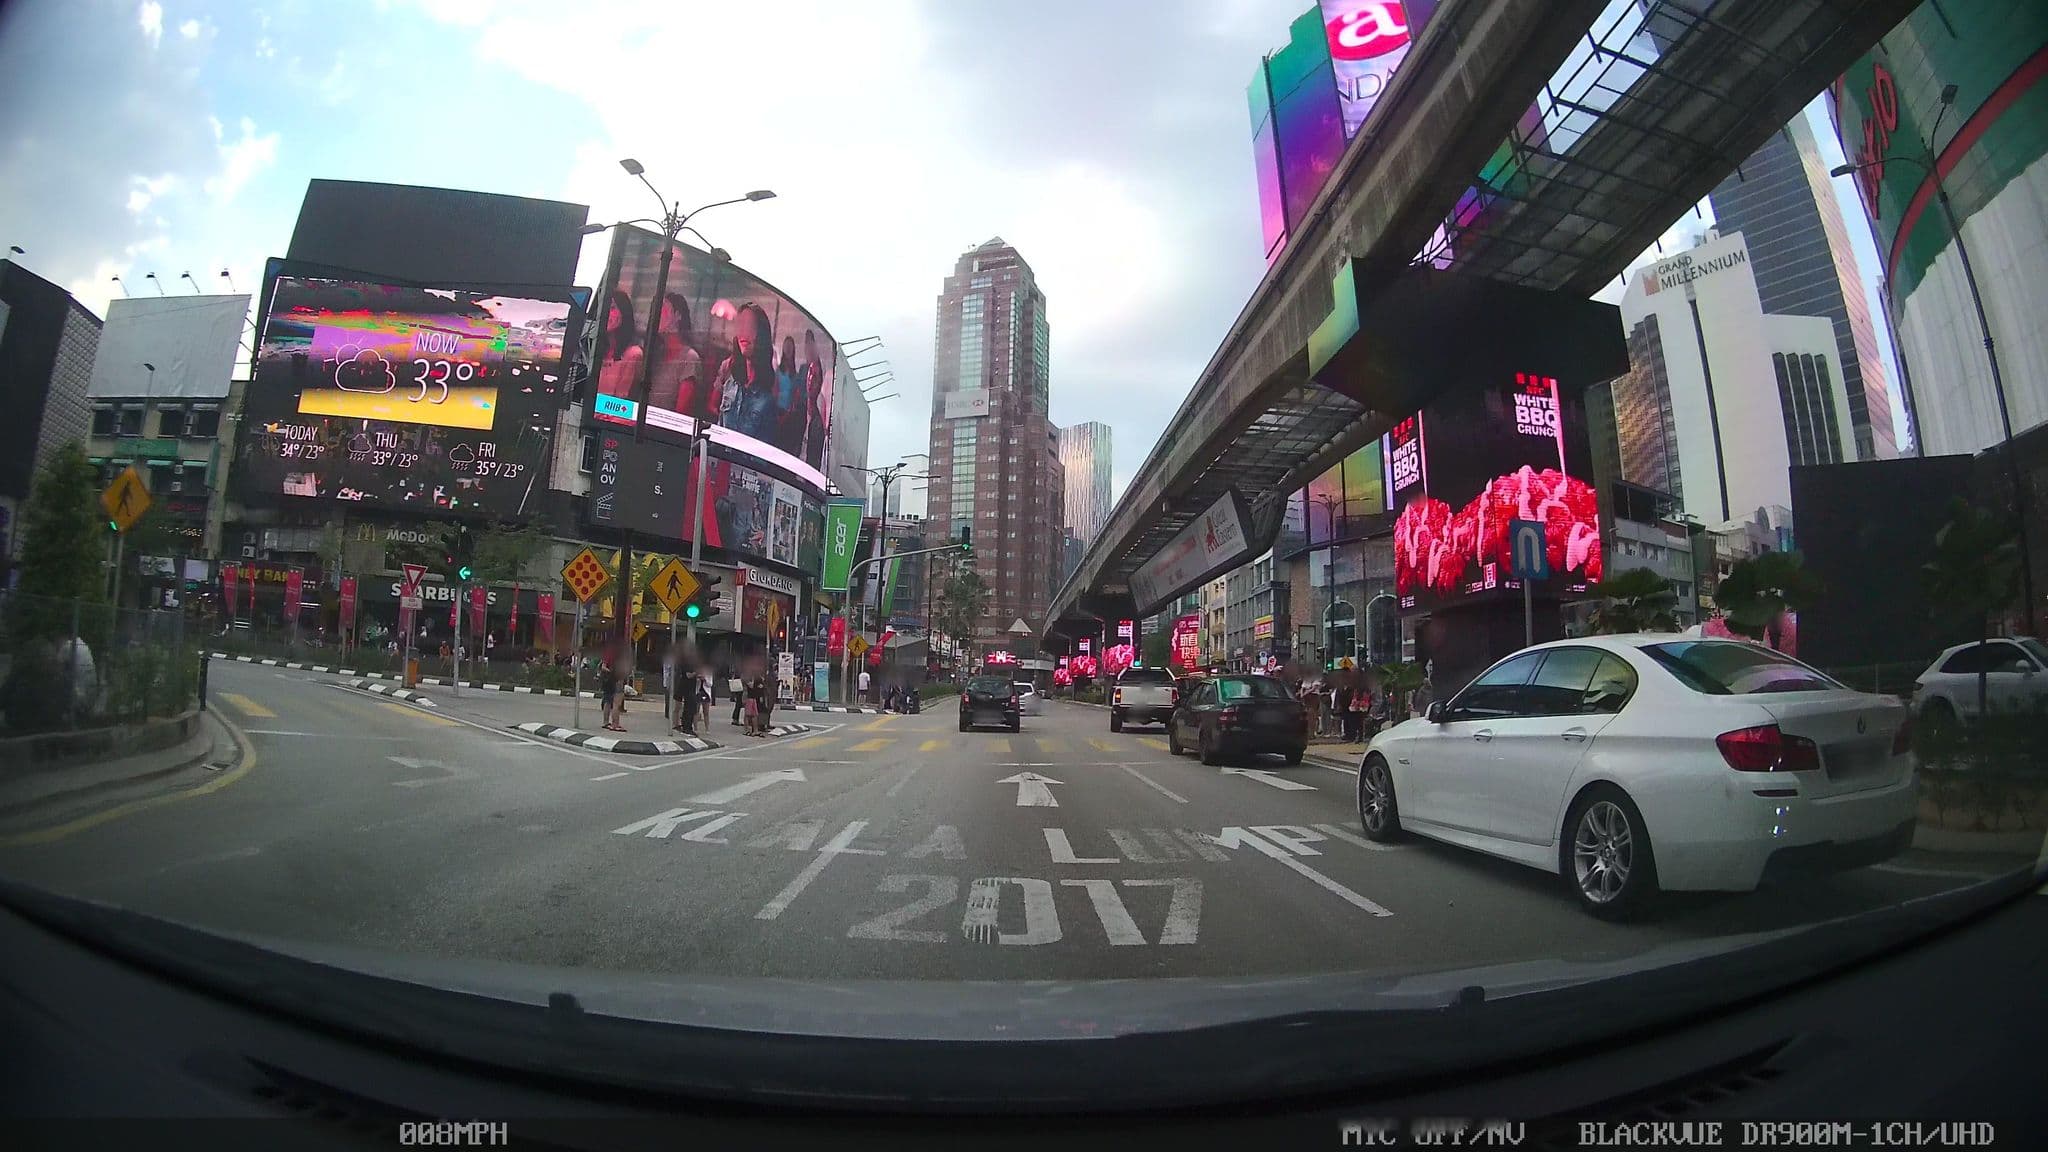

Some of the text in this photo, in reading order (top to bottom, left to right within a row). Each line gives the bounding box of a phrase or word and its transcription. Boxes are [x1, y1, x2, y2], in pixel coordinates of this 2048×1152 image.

[1658, 255, 1692, 275] GRAND
[1661, 249, 1746, 291] MILLENNIUM
[415, 332, 460, 354] NOW
[407, 358, 473, 404] 33°
[1513, 392, 1555, 410] WHITE
[1515, 406, 1558, 429] BBQ
[284, 424, 318, 441] TODAY
[375, 432, 398, 448] THU
[478, 442, 496, 457] FRI
[1392, 438, 1417, 462] WHITE
[1393, 452, 1418, 481] BBQ
[1394, 470, 1419, 491] CRUNCH
[833, 517, 847, 557] acer
[847, 874, 1203, 946] 2017
